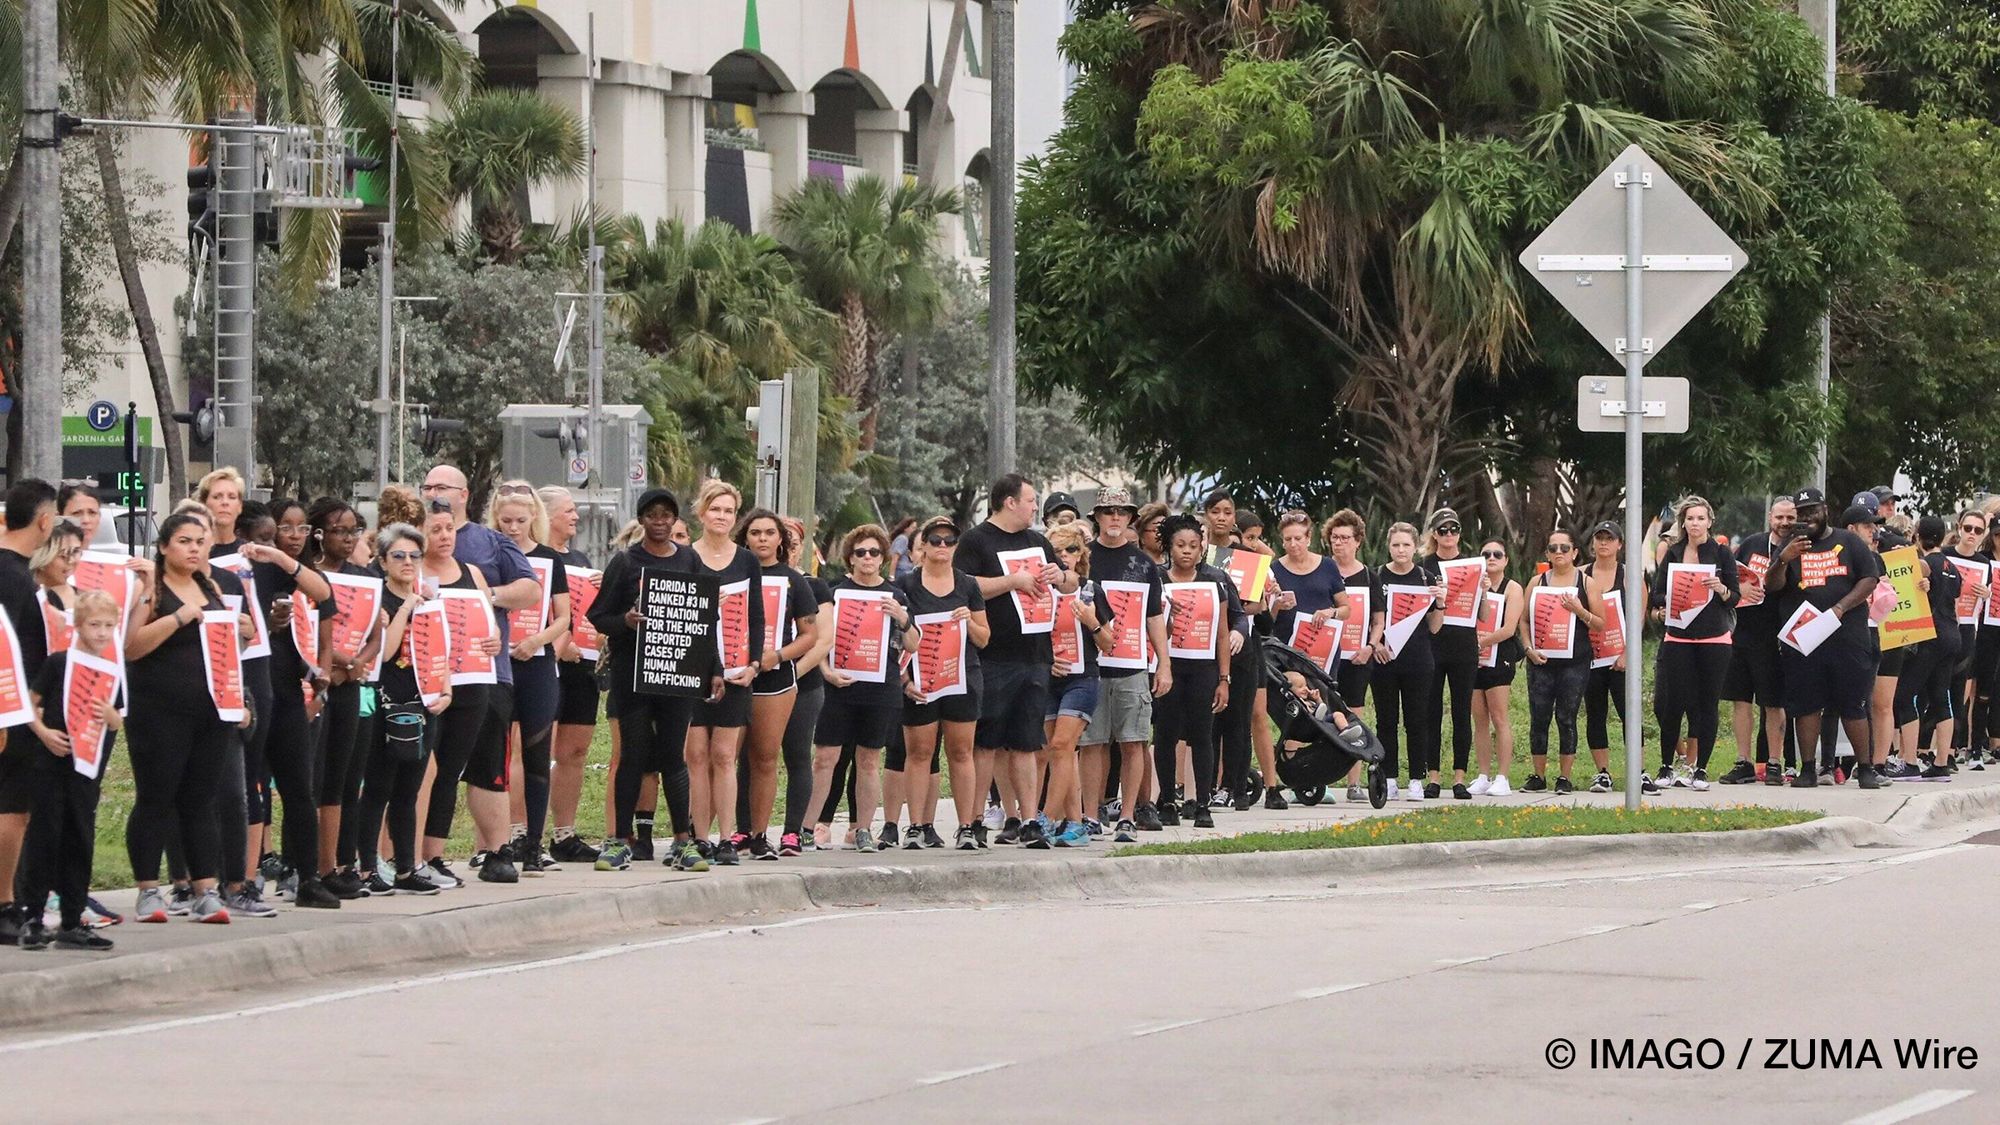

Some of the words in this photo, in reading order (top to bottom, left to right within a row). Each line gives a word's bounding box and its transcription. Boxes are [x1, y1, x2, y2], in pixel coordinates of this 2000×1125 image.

[1803, 551, 1836, 560] ABOLISH
[1803, 560, 1836, 568] SLAVERY
[1825, 567, 1845, 575] EACH
[649, 578, 687, 594] FLORIDA
[688, 582, 697, 595] IS
[648, 592, 685, 606] RANKED
[686, 596, 698, 609] #3
[699, 597, 709, 609] IN
[647, 605, 665, 618] THE
[666, 607, 699, 621] NATION
[646, 618, 664, 631] FOR
[666, 620, 684, 633] THE
[684, 622, 709, 636] MOST
[645, 631, 692, 647] REPORTED
[644, 645, 673, 659] CASES
[674, 648, 687, 660] OF
[643, 658, 677, 672] HUMAN
[643, 671, 701, 688] TRAFFICKING
